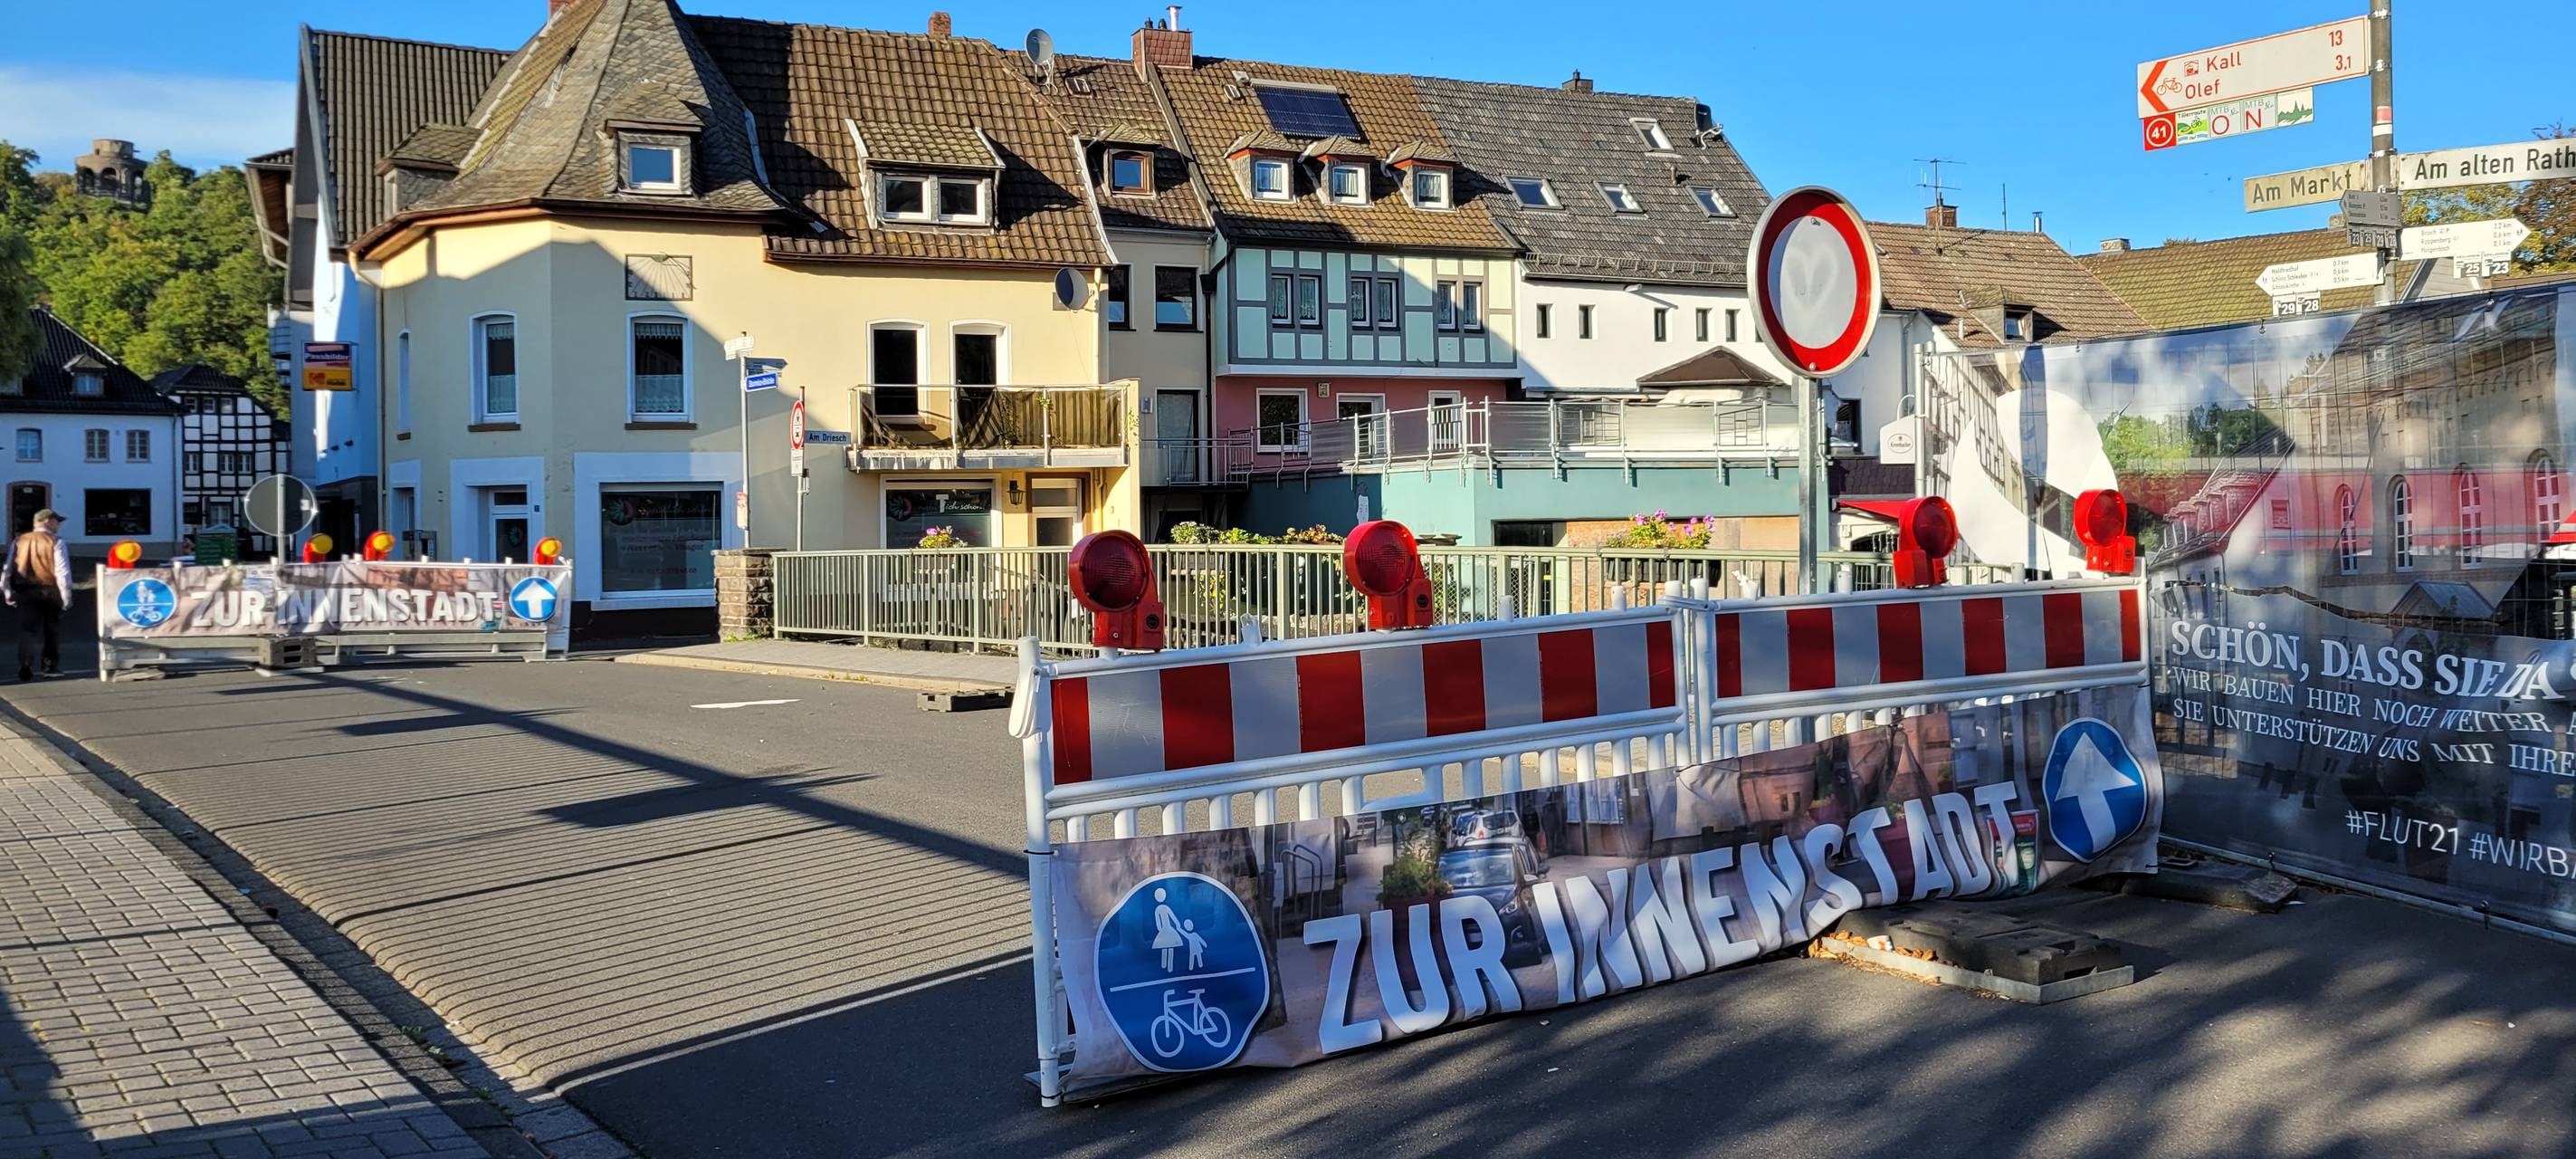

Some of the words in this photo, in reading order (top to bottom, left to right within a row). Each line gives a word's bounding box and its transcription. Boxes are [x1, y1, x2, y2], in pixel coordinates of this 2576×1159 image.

[2328, 30, 2343, 47] 13
[2206, 51, 2242, 72] Kall
[2335, 54, 2352, 71] 3,1
[2185, 80, 2220, 100] Olef
[2210, 106, 2229, 116] MTB
[2245, 99, 2265, 109] MTB
[2211, 115, 2229, 135] O
[2246, 108, 2262, 130] N
[2151, 127, 2167, 139] 41
[2414, 158, 2448, 180] Am
[2460, 153, 2514, 177] alten
[2253, 183, 2282, 204] Am
[2290, 168, 2352, 197] Markt
[2466, 263, 2480, 273] 25
[2494, 262, 2509, 274] 23
[2281, 303, 2295, 315] 29
[2304, 300, 2319, 311] 28
[808, 433, 820, 441] Am
[822, 434, 847, 442] Driesch
[191, 589, 265, 627] ZUR
[274, 587, 498, 625] INNENSTADT
[2171, 620, 2310, 683] SCHÖN,
[2321, 638, 2424, 690] DASS
[2434, 654, 2506, 698] SIE
[2172, 666, 2211, 692] WIR
[2223, 674, 2295, 705] BAUEN
[2307, 686, 2361, 717] HIER
[2372, 698, 2438, 728] NOCH
[2439, 708, 2552, 734] WEITER
[2173, 697, 2204, 723] SIE
[2212, 705, 2377, 754] UNTERSTÜTZEN
[2378, 736, 2421, 763] UNS
[2430, 742, 2495, 765] MIT
[2345, 809, 2459, 856] #FLUT21
[2468, 832, 2576, 881] #WIRB
[1302, 892, 1522, 1055] ZUR
[1531, 781, 2019, 1005] INNENSTADT
